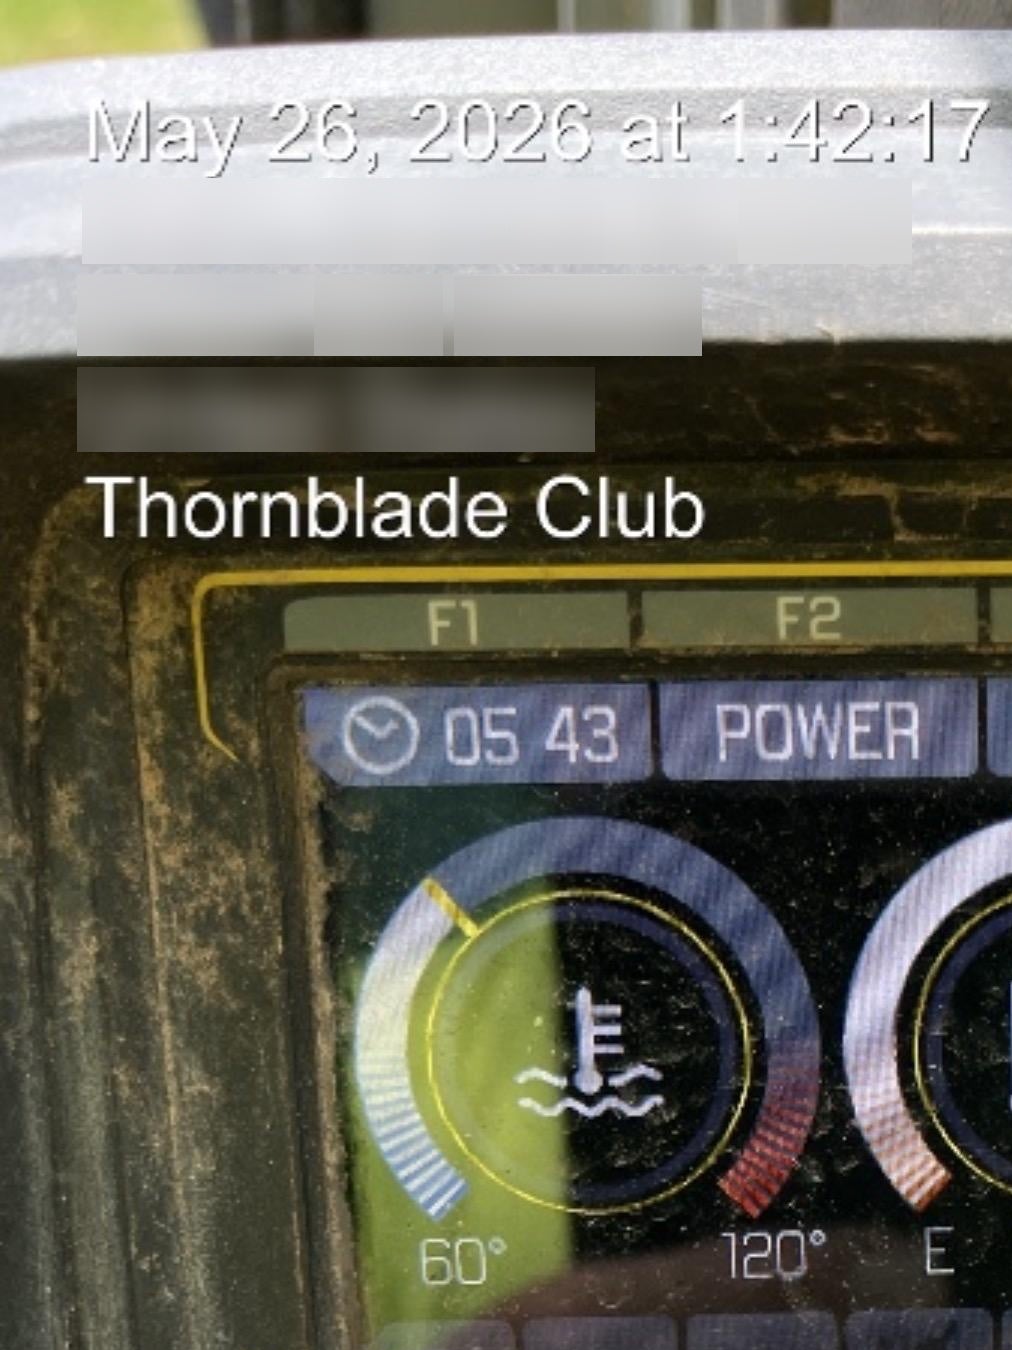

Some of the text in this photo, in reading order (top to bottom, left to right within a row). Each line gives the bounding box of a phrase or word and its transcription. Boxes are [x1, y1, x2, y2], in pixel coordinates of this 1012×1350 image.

[427, 600, 480, 646] F1
[776, 596, 842, 641] F2
[445, 706, 619, 766] 05 43
[716, 701, 920, 763] POWER
[923, 1226, 955, 1276] E
